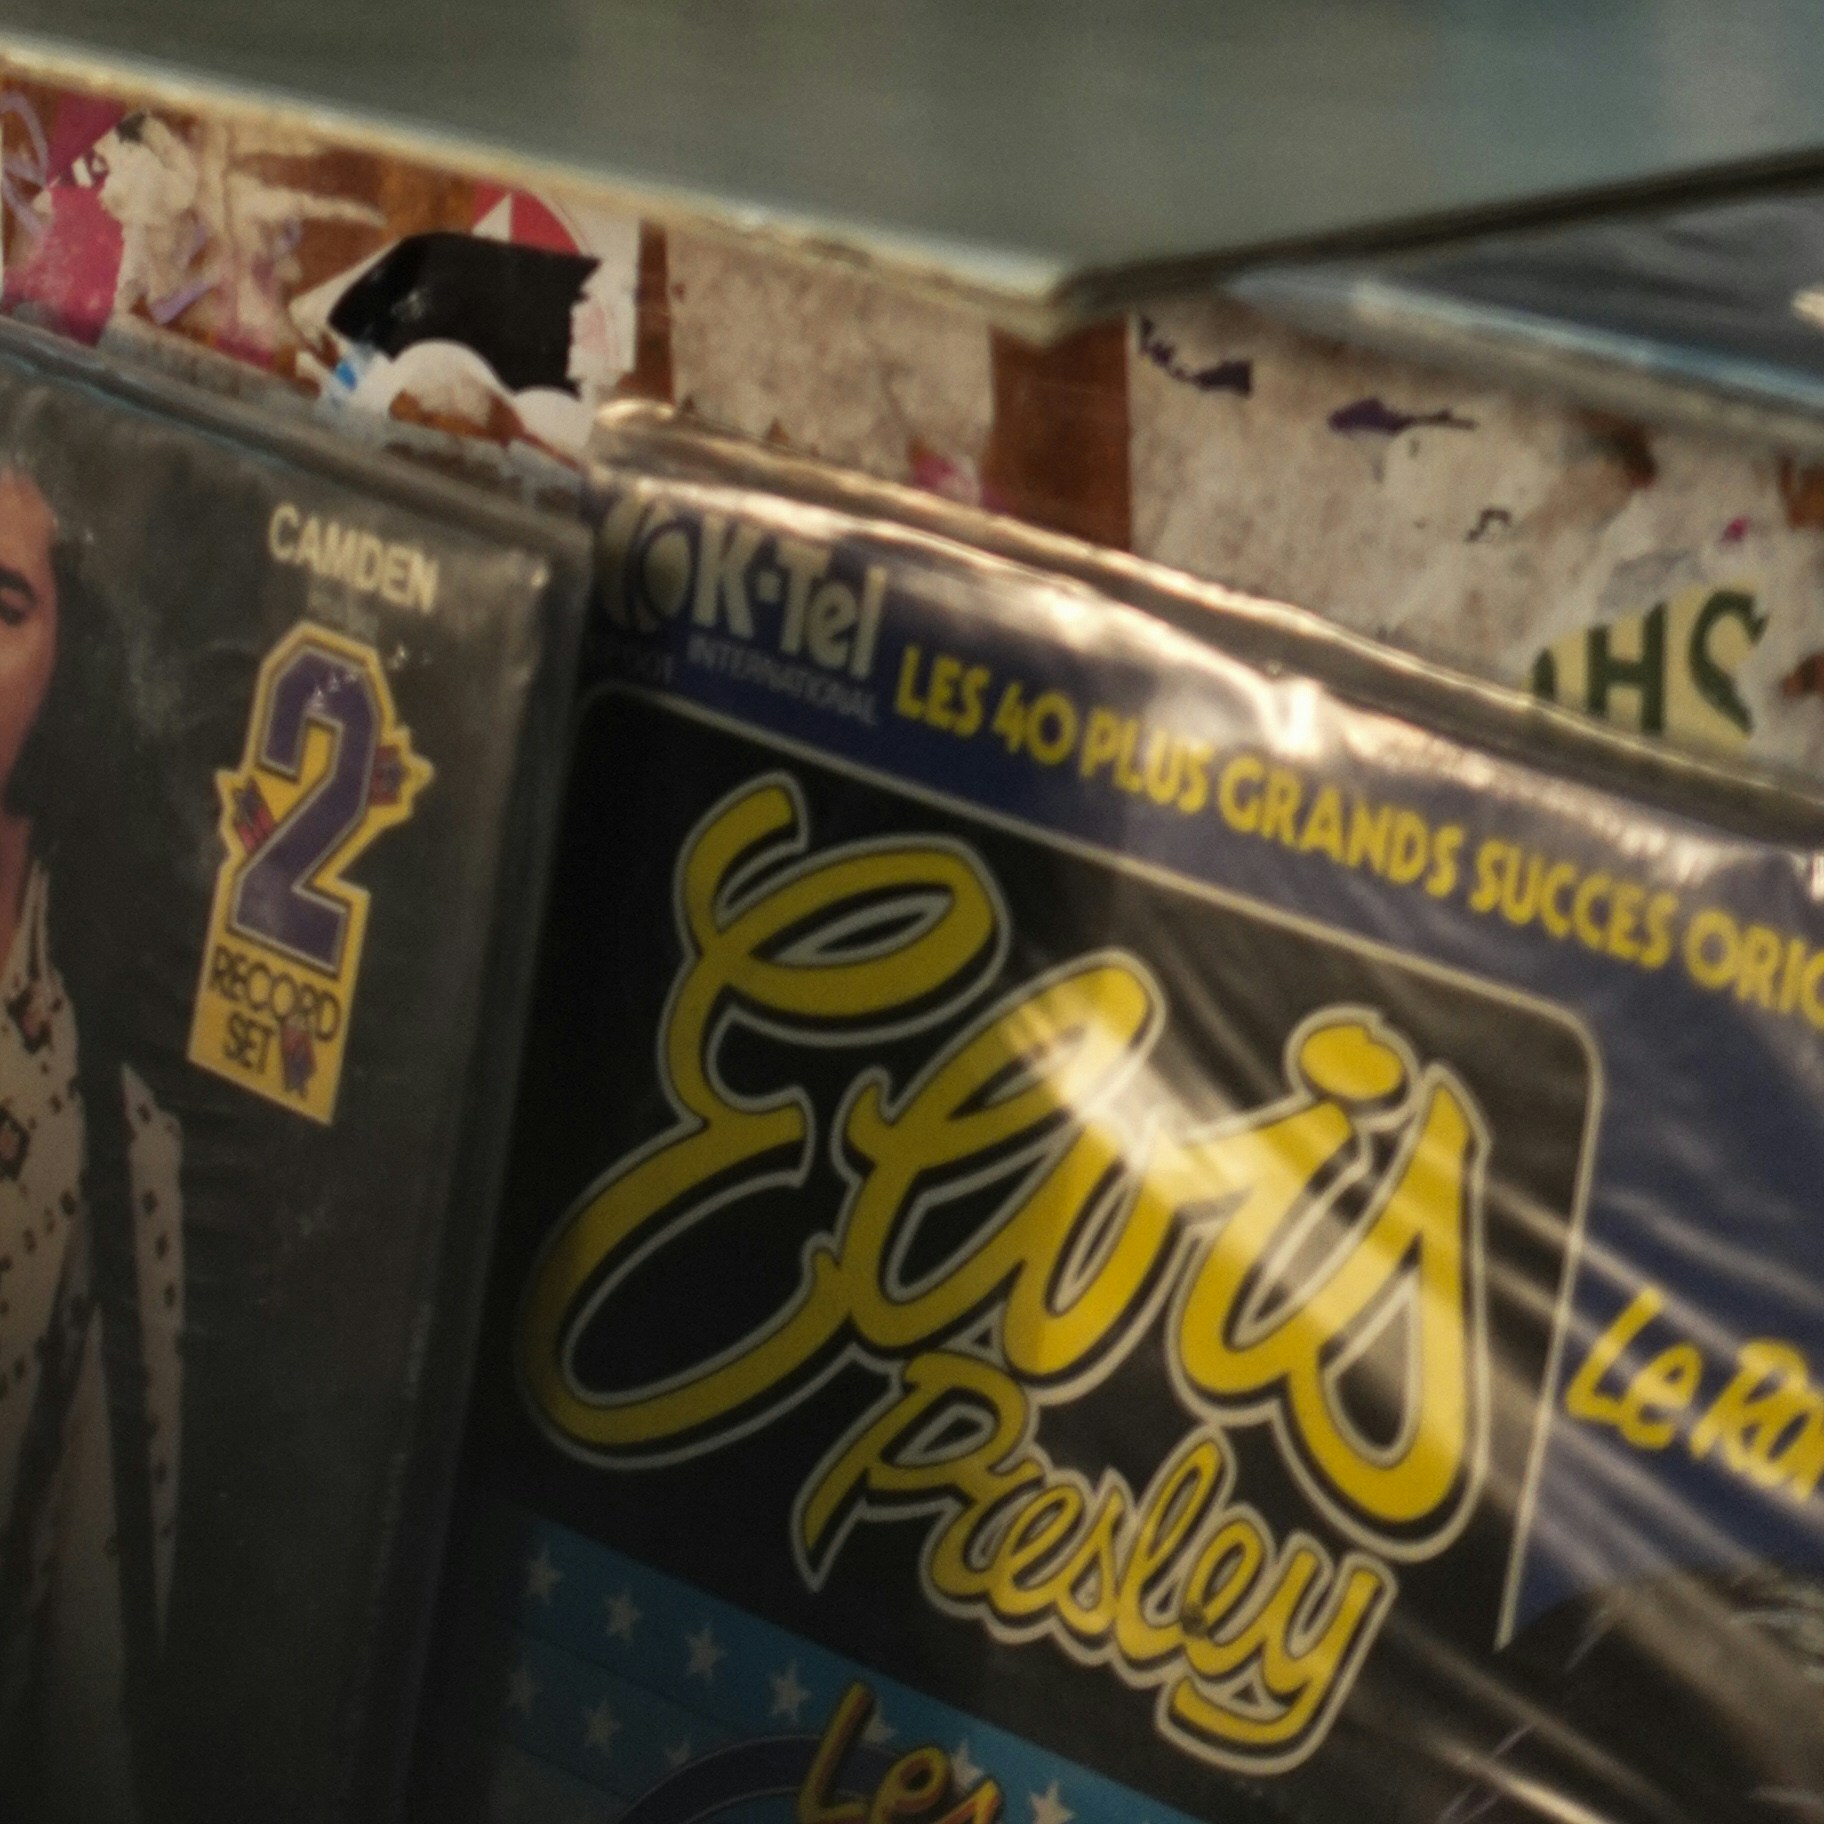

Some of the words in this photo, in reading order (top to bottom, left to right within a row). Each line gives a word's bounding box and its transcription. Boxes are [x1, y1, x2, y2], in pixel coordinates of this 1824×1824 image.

[266, 503, 442, 615] CAMDEN
[226, 647, 375, 979] 2
[892, 642, 991, 740] LES
[991, 679, 1076, 766] 40
[1081, 706, 1211, 816] PLUS
[1218, 754, 1465, 899] GRANDS
[1469, 837, 1678, 971] SUCCES
[210, 946, 342, 1042] RECORD
[223, 1012, 274, 1076] SET
[516, 772, 1492, 1562] Elvis
[1565, 1287, 1704, 1449] Le
[794, 1348, 1397, 1774] Presley
